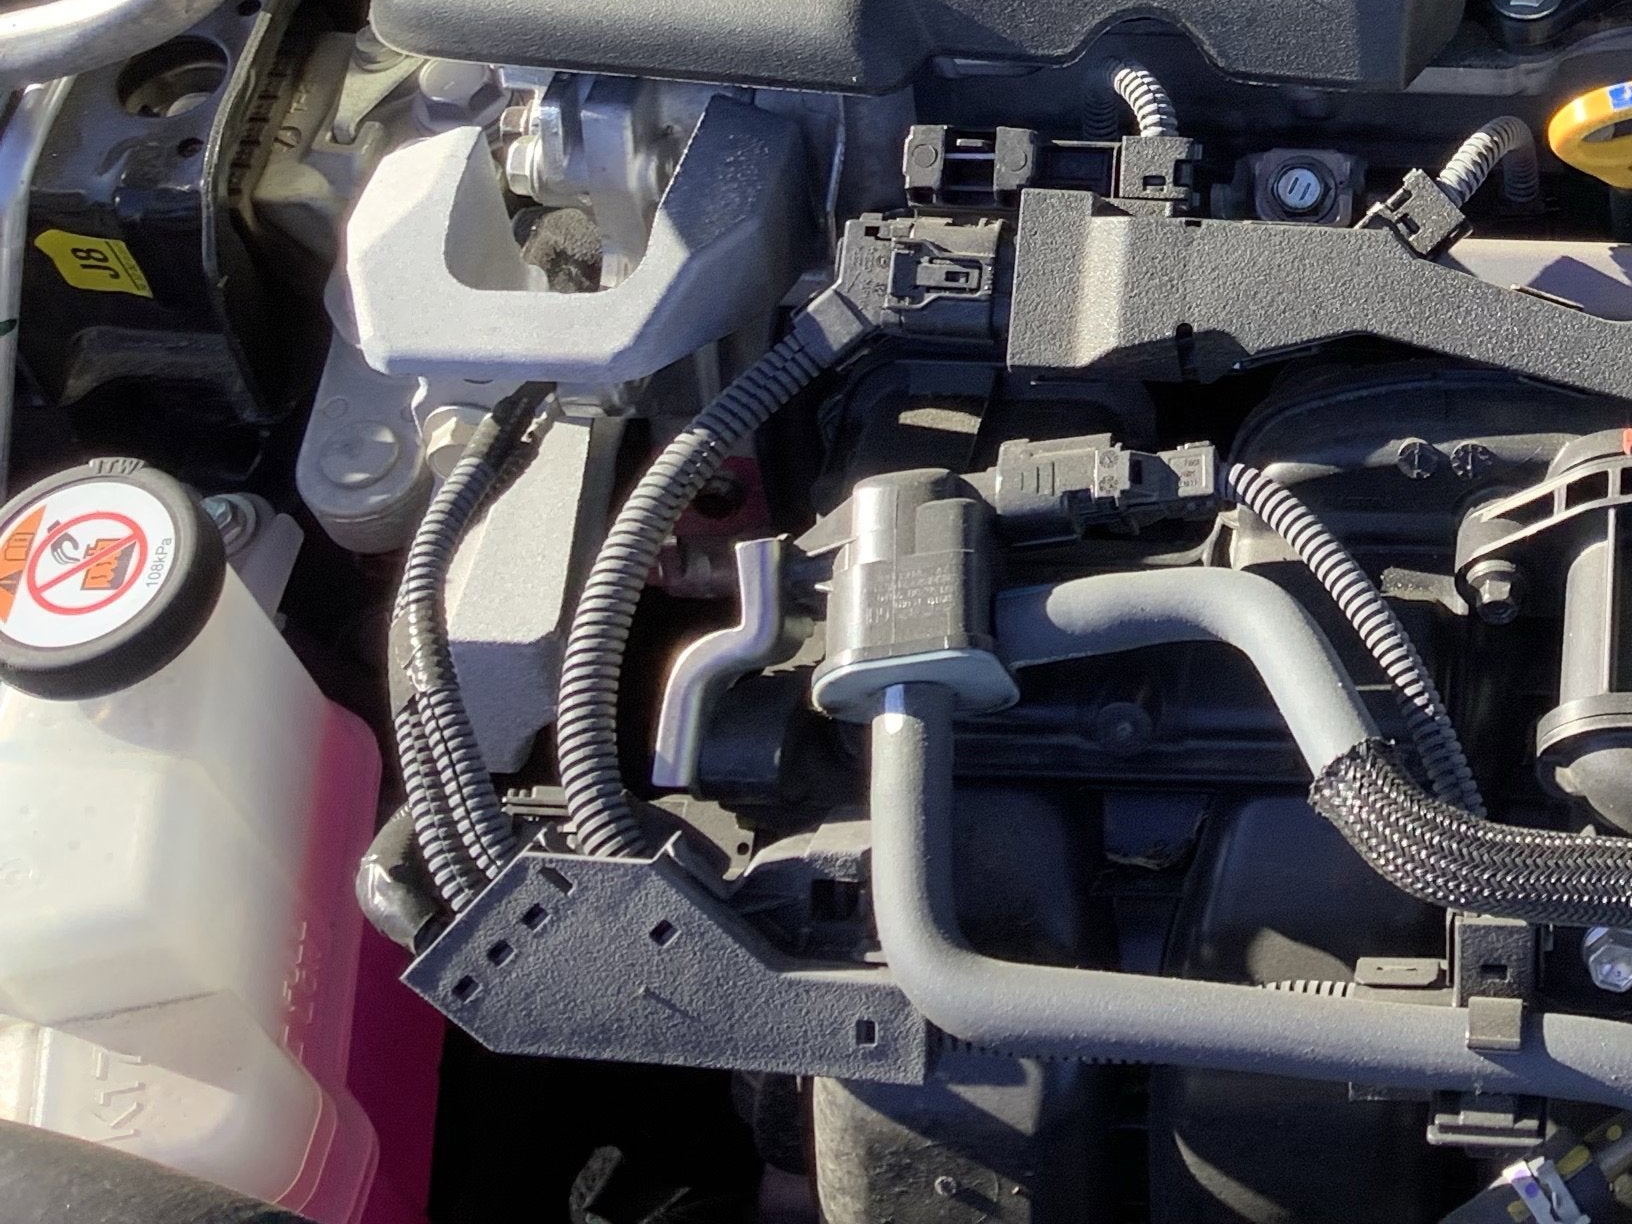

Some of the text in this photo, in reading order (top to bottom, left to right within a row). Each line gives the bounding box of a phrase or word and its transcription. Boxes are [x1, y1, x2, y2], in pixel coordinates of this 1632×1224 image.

[71, 247, 121, 280] J8
[95, 458, 145, 475] ITW
[146, 537, 173, 588] 108kPa
